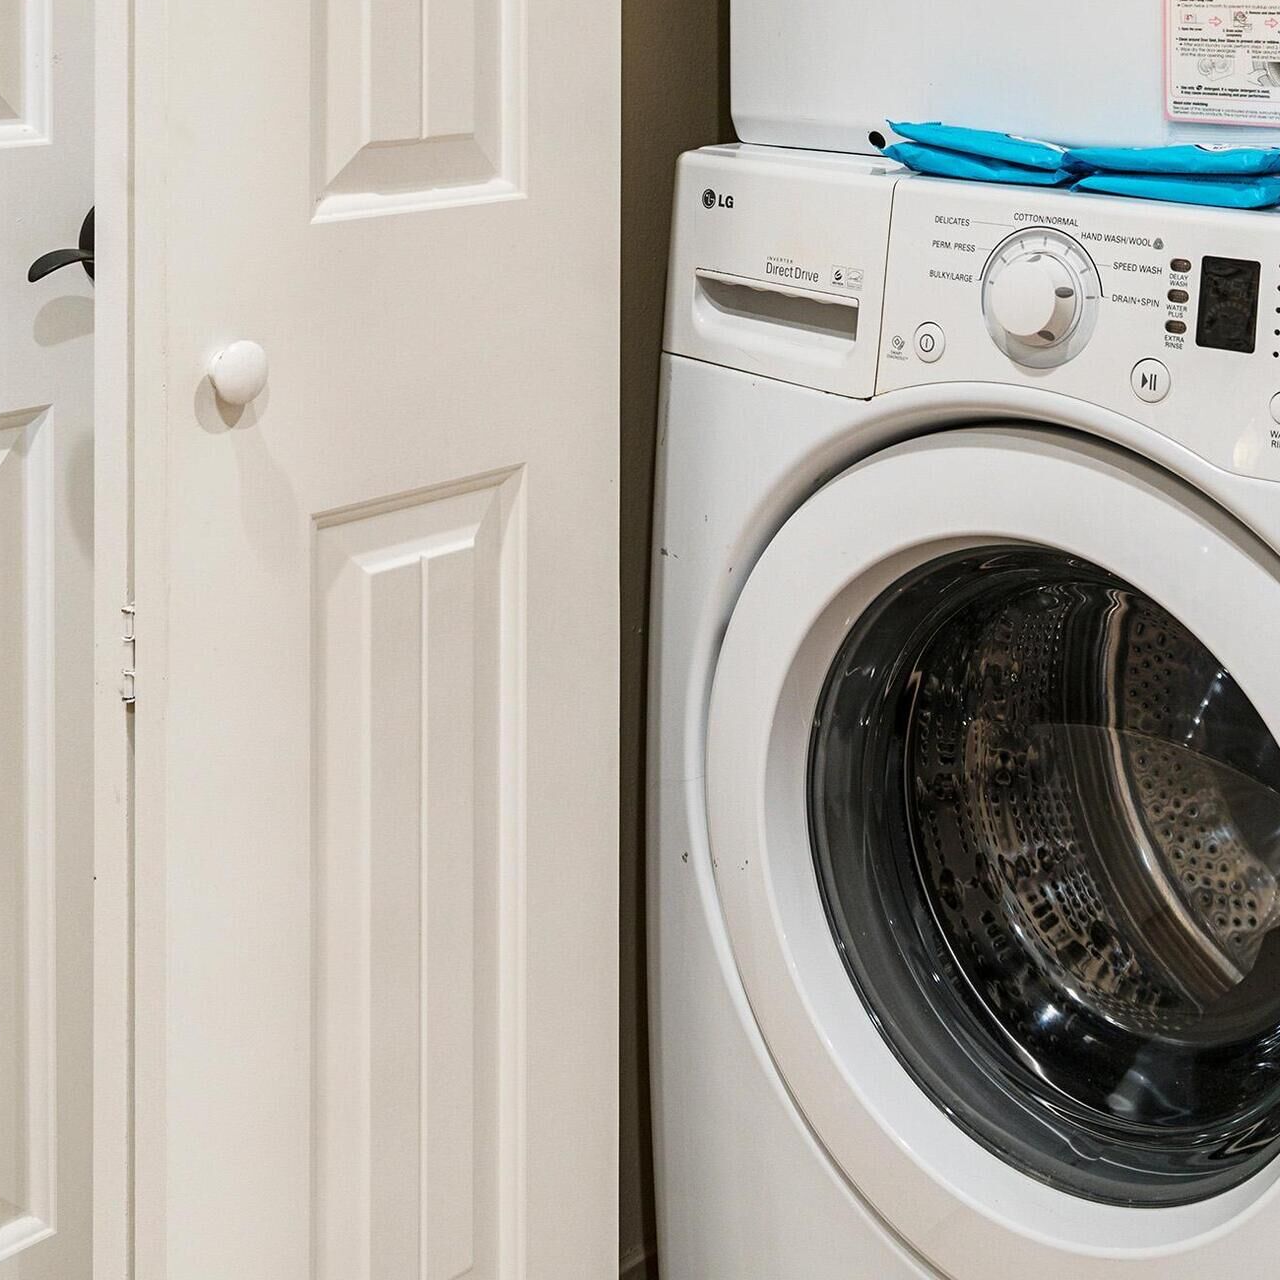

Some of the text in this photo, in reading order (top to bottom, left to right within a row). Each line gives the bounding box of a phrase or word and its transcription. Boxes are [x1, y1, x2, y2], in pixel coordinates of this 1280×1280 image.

[718, 194, 734, 208] LG
[934, 215, 970, 226] DELICATES
[1014, 212, 1079, 227] COTTON/NORMAL
[1081, 231, 1152, 247] HAND WASH/WOOL
[954, 241, 976, 252] PRESS
[767, 255, 794, 263] INVERTER
[1113, 261, 1163, 275] SPEED WASH
[929, 269, 973, 283] BULKY/LARGE
[1170, 273, 1189, 281] DELAY
[1166, 304, 1188, 312] WATER
[1168, 311, 1184, 319] PLUS
[1164, 334, 1185, 343] EXTRA
[1165, 341, 1183, 350] RINSE
